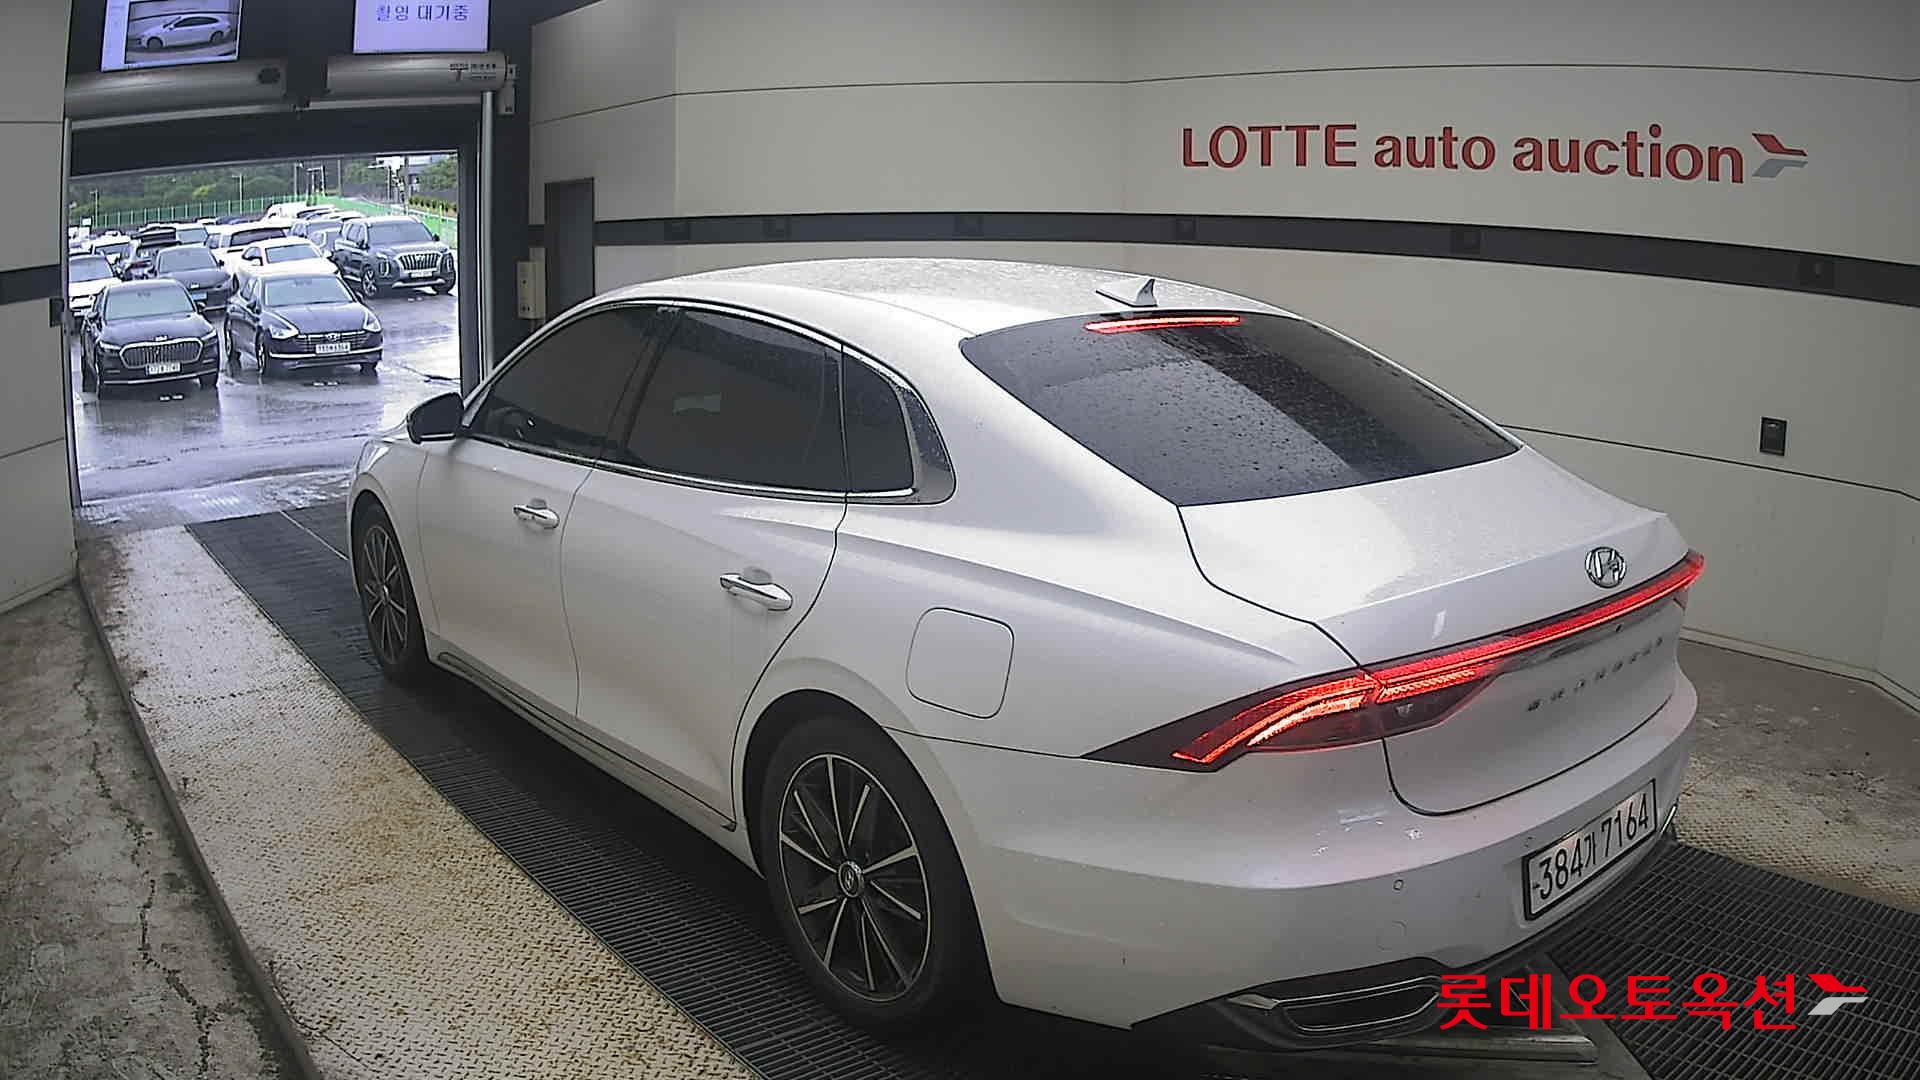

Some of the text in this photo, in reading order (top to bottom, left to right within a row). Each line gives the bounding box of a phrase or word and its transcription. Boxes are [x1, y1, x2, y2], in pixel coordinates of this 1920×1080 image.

[417, 5, 469, 21] 대기중
[1183, 124, 1745, 183] LOTTE auto auction
